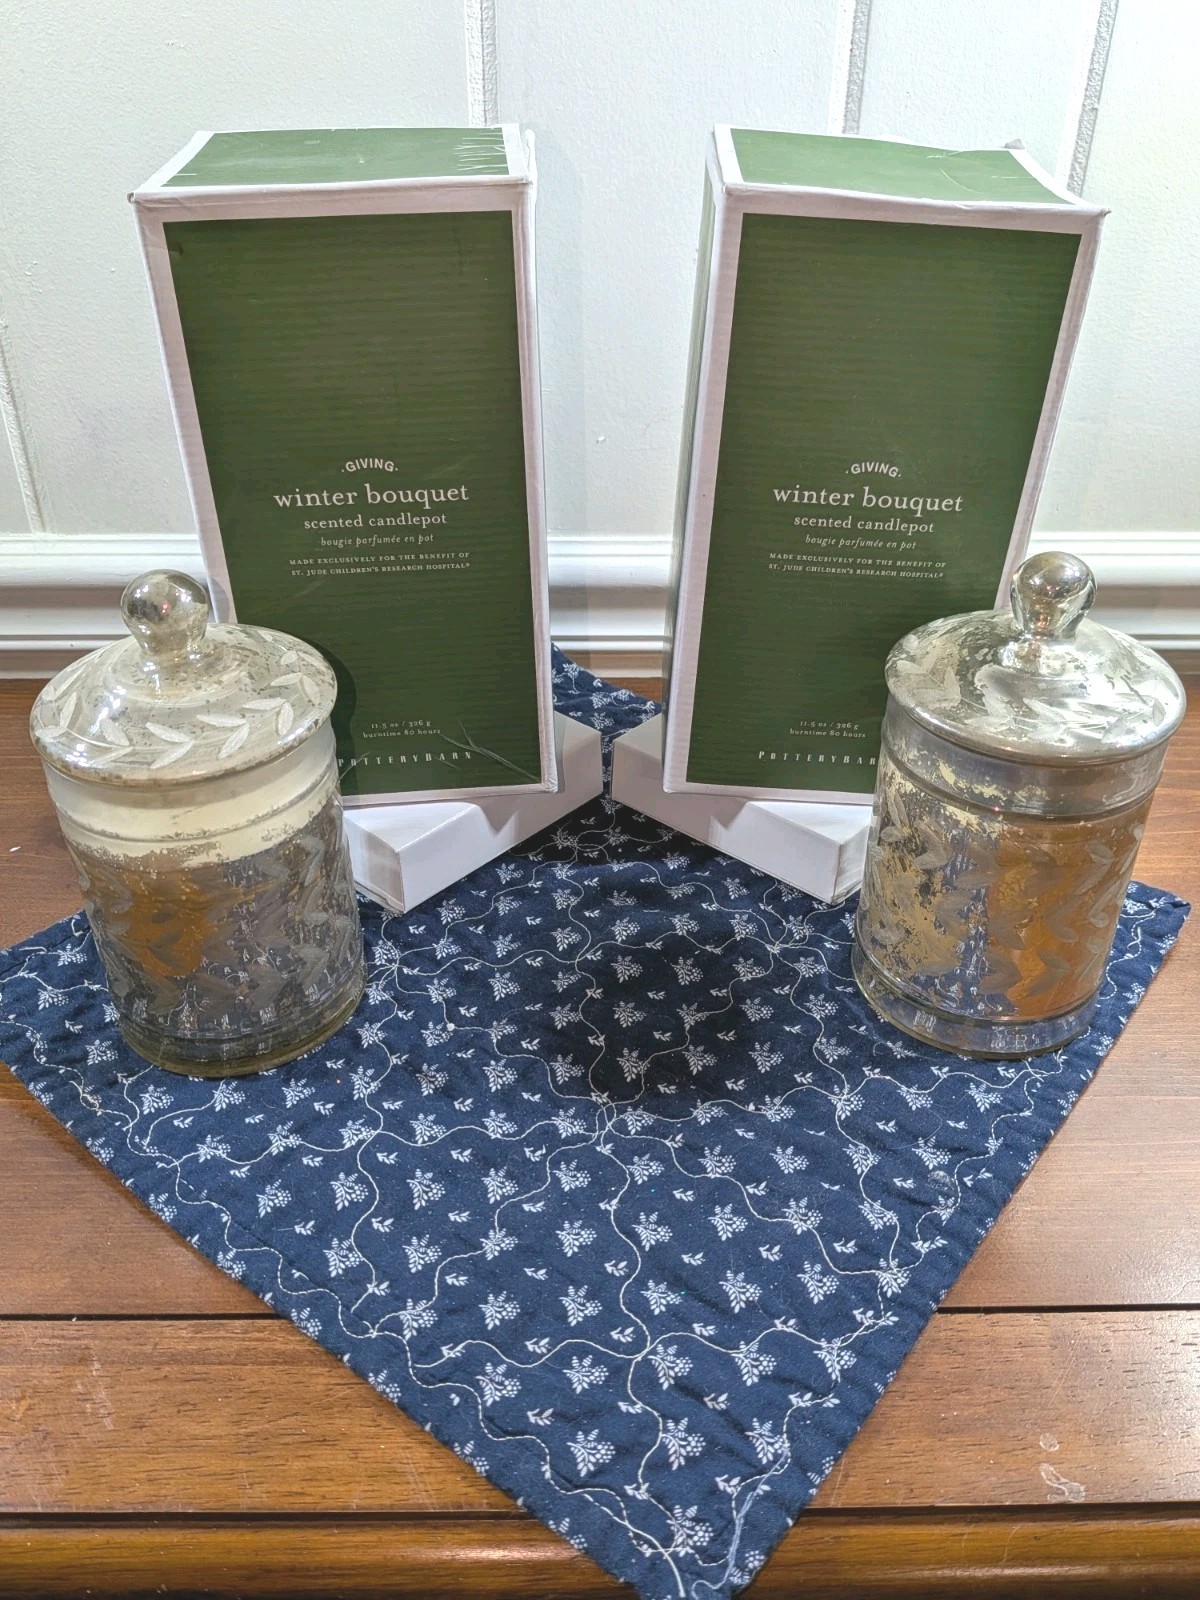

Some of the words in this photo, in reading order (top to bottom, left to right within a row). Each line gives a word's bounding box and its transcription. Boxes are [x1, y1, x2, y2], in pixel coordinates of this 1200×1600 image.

[273, 488, 358, 508] winter
[364, 483, 470, 510] bouquet
[773, 484, 855, 506] winter
[862, 486, 964, 518] bouquet
[304, 514, 364, 530] scented
[368, 512, 448, 531] candlepot
[794, 515, 852, 530] scented
[857, 517, 935, 536] candlepot
[320, 536, 353, 548] bougie
[355, 534, 401, 548] parfumée
[404, 535, 415, 543] en
[417, 534, 434, 544] pot
[805, 534, 837, 548] bougie
[838, 537, 884, 549] parfumée
[886, 541, 897, 549] en
[899, 540, 917, 552] pot
[289, 558, 315, 566] MADE
[317, 556, 376, 564] EXCLUSIVELY
[419, 552, 456, 560] BENEFIT
[769, 552, 794, 560] MADE
[796, 554, 854, 564] EXCLUSIVELY
[306, 568, 328, 577] JUDE
[381, 564, 424, 572] RESEARCH
[782, 564, 804, 572] JUDE
[855, 568, 898, 577] RESEARCH
[408, 719, 424, 727] 326
[362, 730, 401, 739] burntime
[789, 728, 827, 736] burntime
[842, 730, 866, 738] hours
[758, 750, 877, 766] POTTERYBAR
